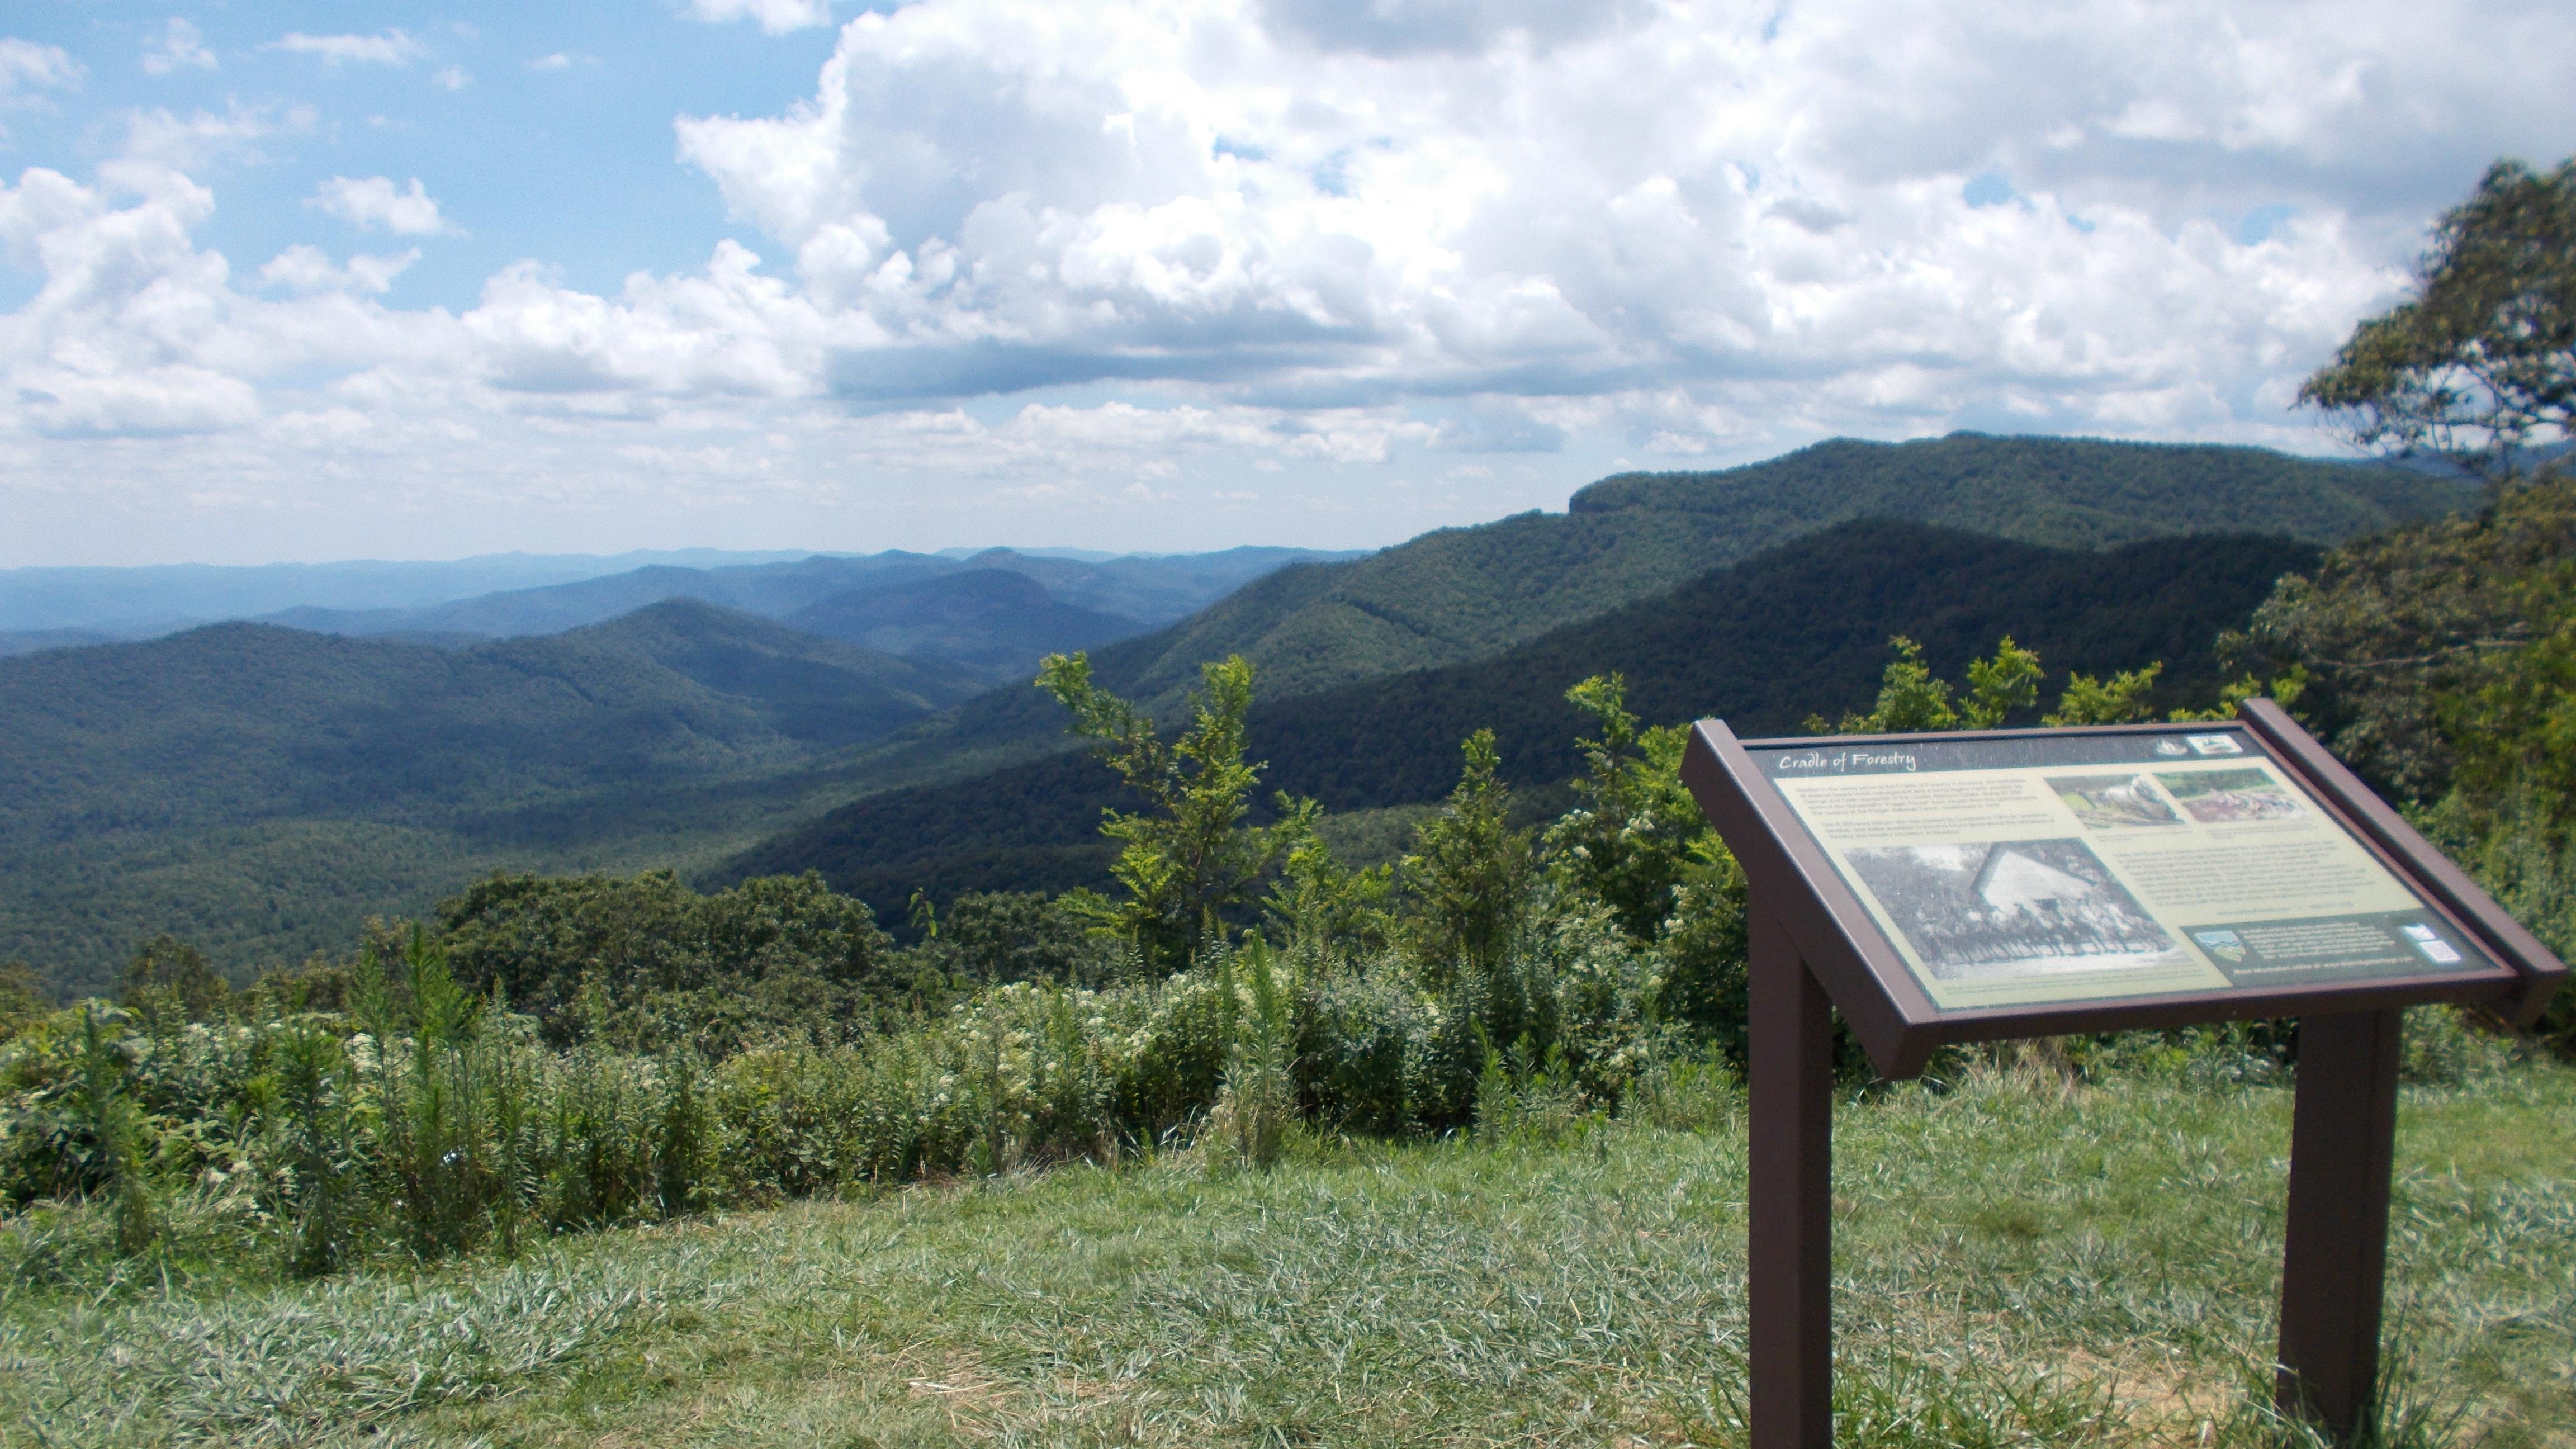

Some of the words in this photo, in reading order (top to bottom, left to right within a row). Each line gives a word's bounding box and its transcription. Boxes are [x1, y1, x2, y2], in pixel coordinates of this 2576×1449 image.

[1779, 752, 1827, 769] Cradle
[1833, 752, 1847, 772] of
[1853, 751, 1916, 771] Forestry
